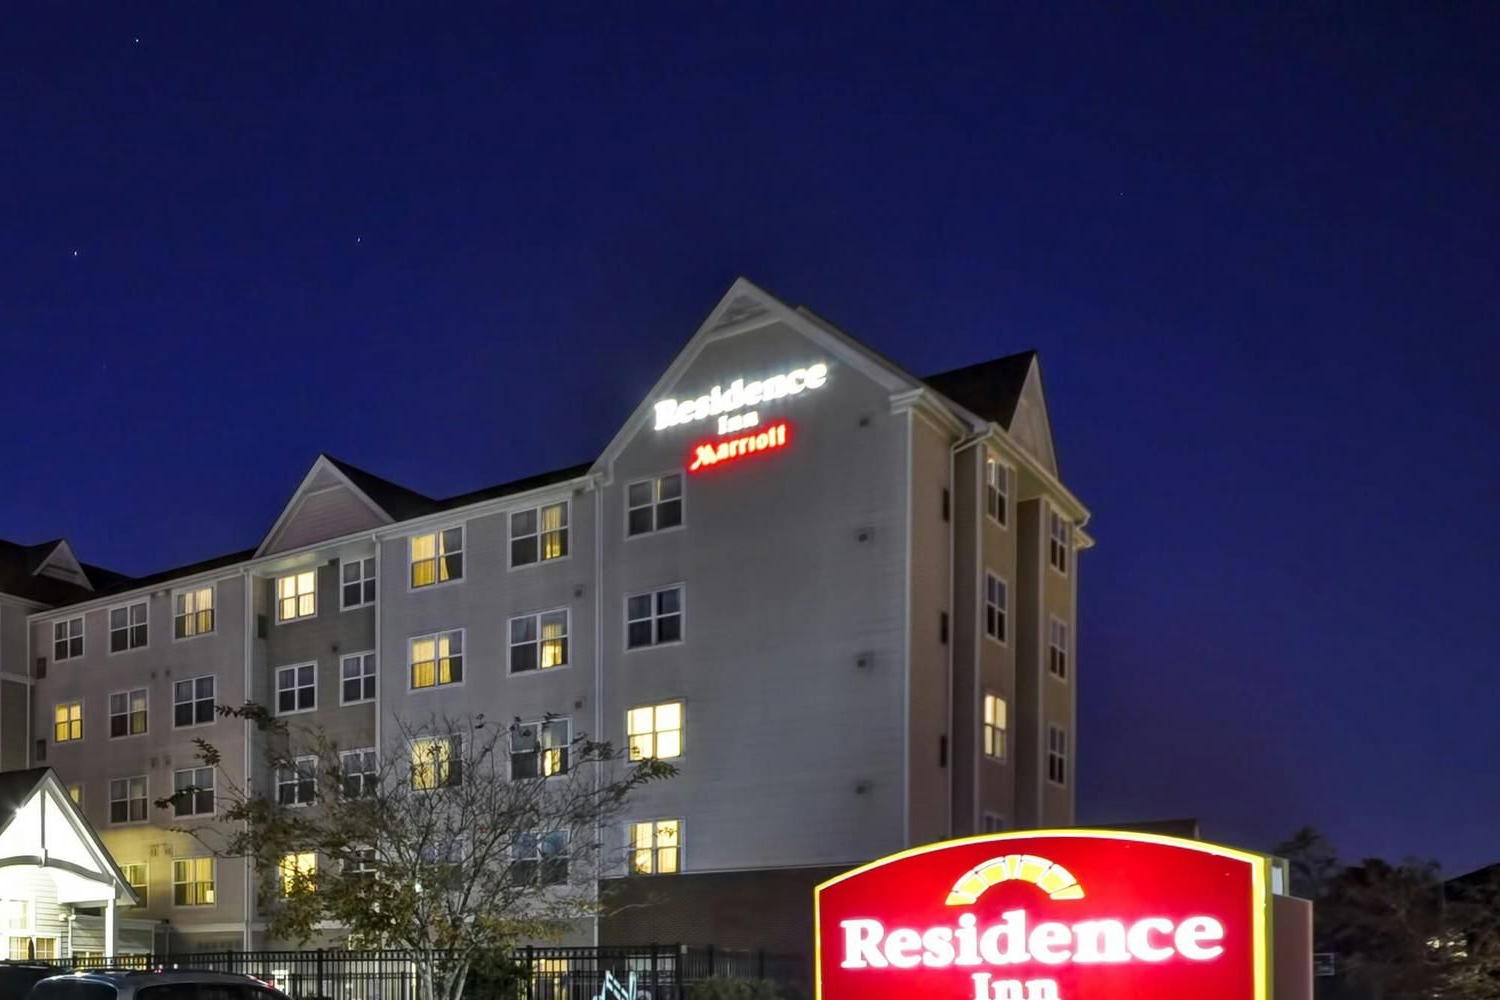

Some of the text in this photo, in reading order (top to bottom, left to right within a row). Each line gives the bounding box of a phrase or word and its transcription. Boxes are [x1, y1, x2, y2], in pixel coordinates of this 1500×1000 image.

[654, 363, 828, 431] Residence
[717, 411, 759, 435] Inn
[689, 424, 787, 471] Marriott
[839, 909, 1225, 969] Residence
